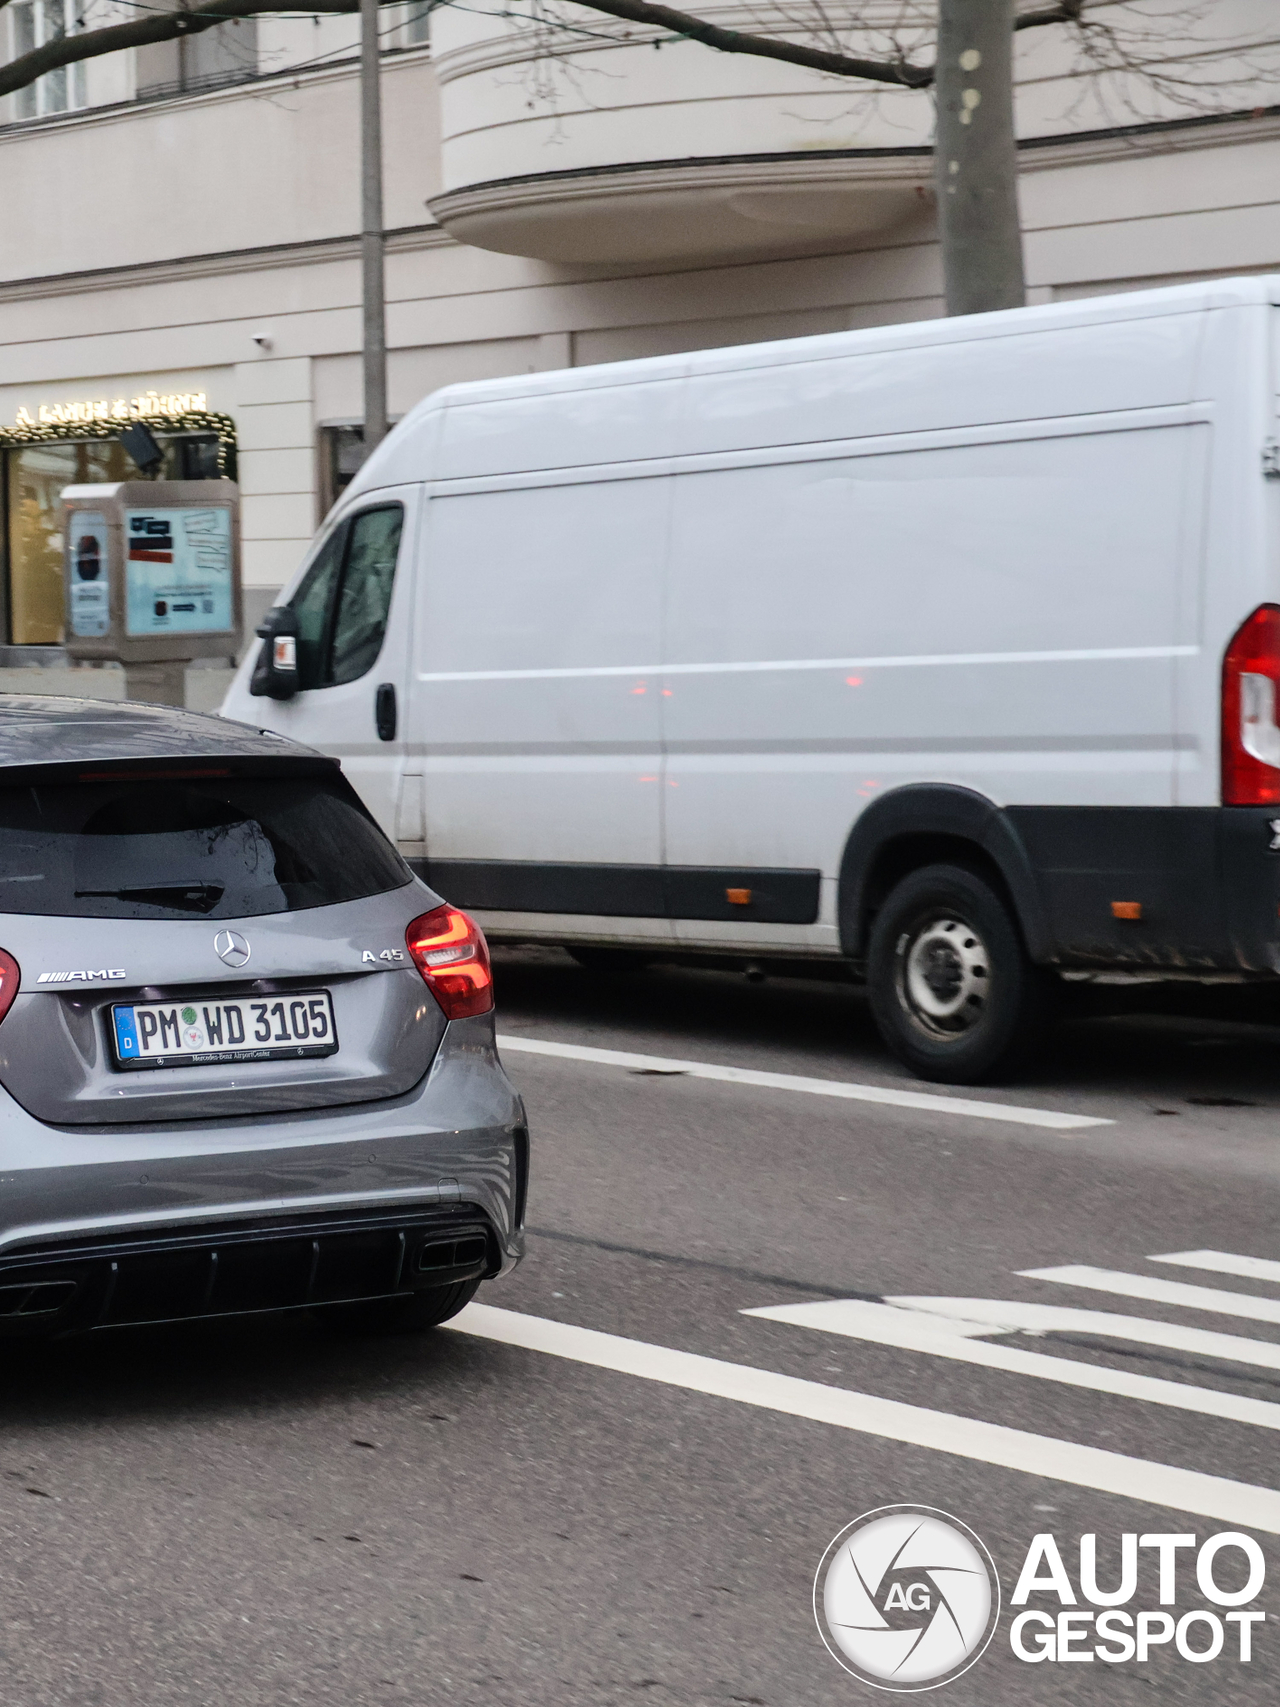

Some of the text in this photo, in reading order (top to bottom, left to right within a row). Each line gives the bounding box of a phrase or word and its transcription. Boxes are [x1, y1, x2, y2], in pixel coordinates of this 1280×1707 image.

[361, 948, 405, 963] A 45
[65, 968, 126, 982] AMG
[123, 999, 328, 1050] D PM WD 3105
[192, 1052, 233, 1062] Mercedes-Benz
